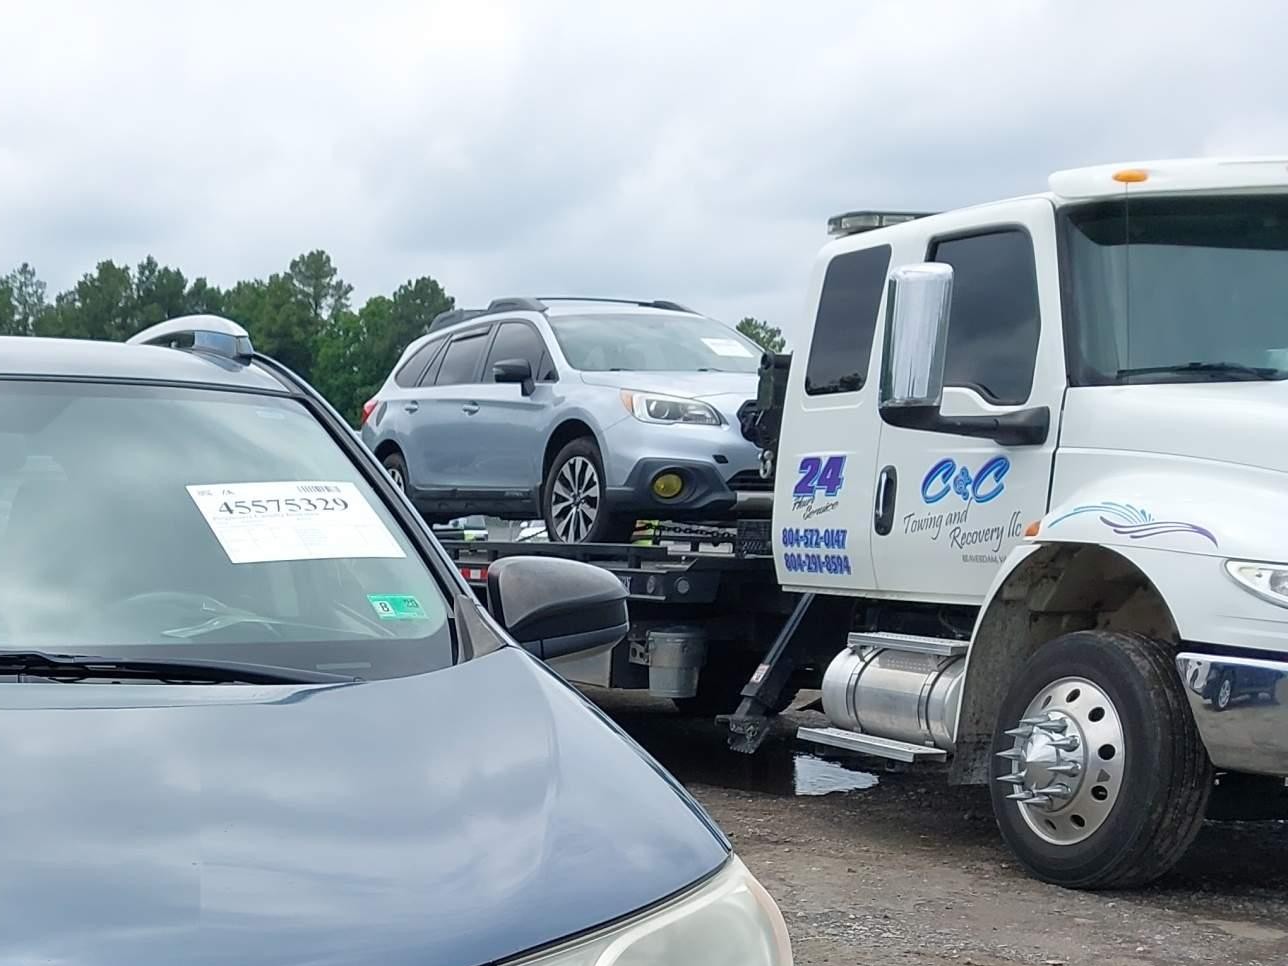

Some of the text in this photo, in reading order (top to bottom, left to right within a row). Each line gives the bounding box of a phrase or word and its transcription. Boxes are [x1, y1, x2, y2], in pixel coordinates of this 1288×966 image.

[793, 456, 847, 497] 24
[920, 454, 1011, 505] C&C
[218, 496, 349, 515] 45575329
[903, 497, 973, 540] Towing and
[782, 528, 848, 550] 804-572-0147
[949, 510, 1022, 553] Recovery llc
[784, 553, 851, 575] 804-291-8594
